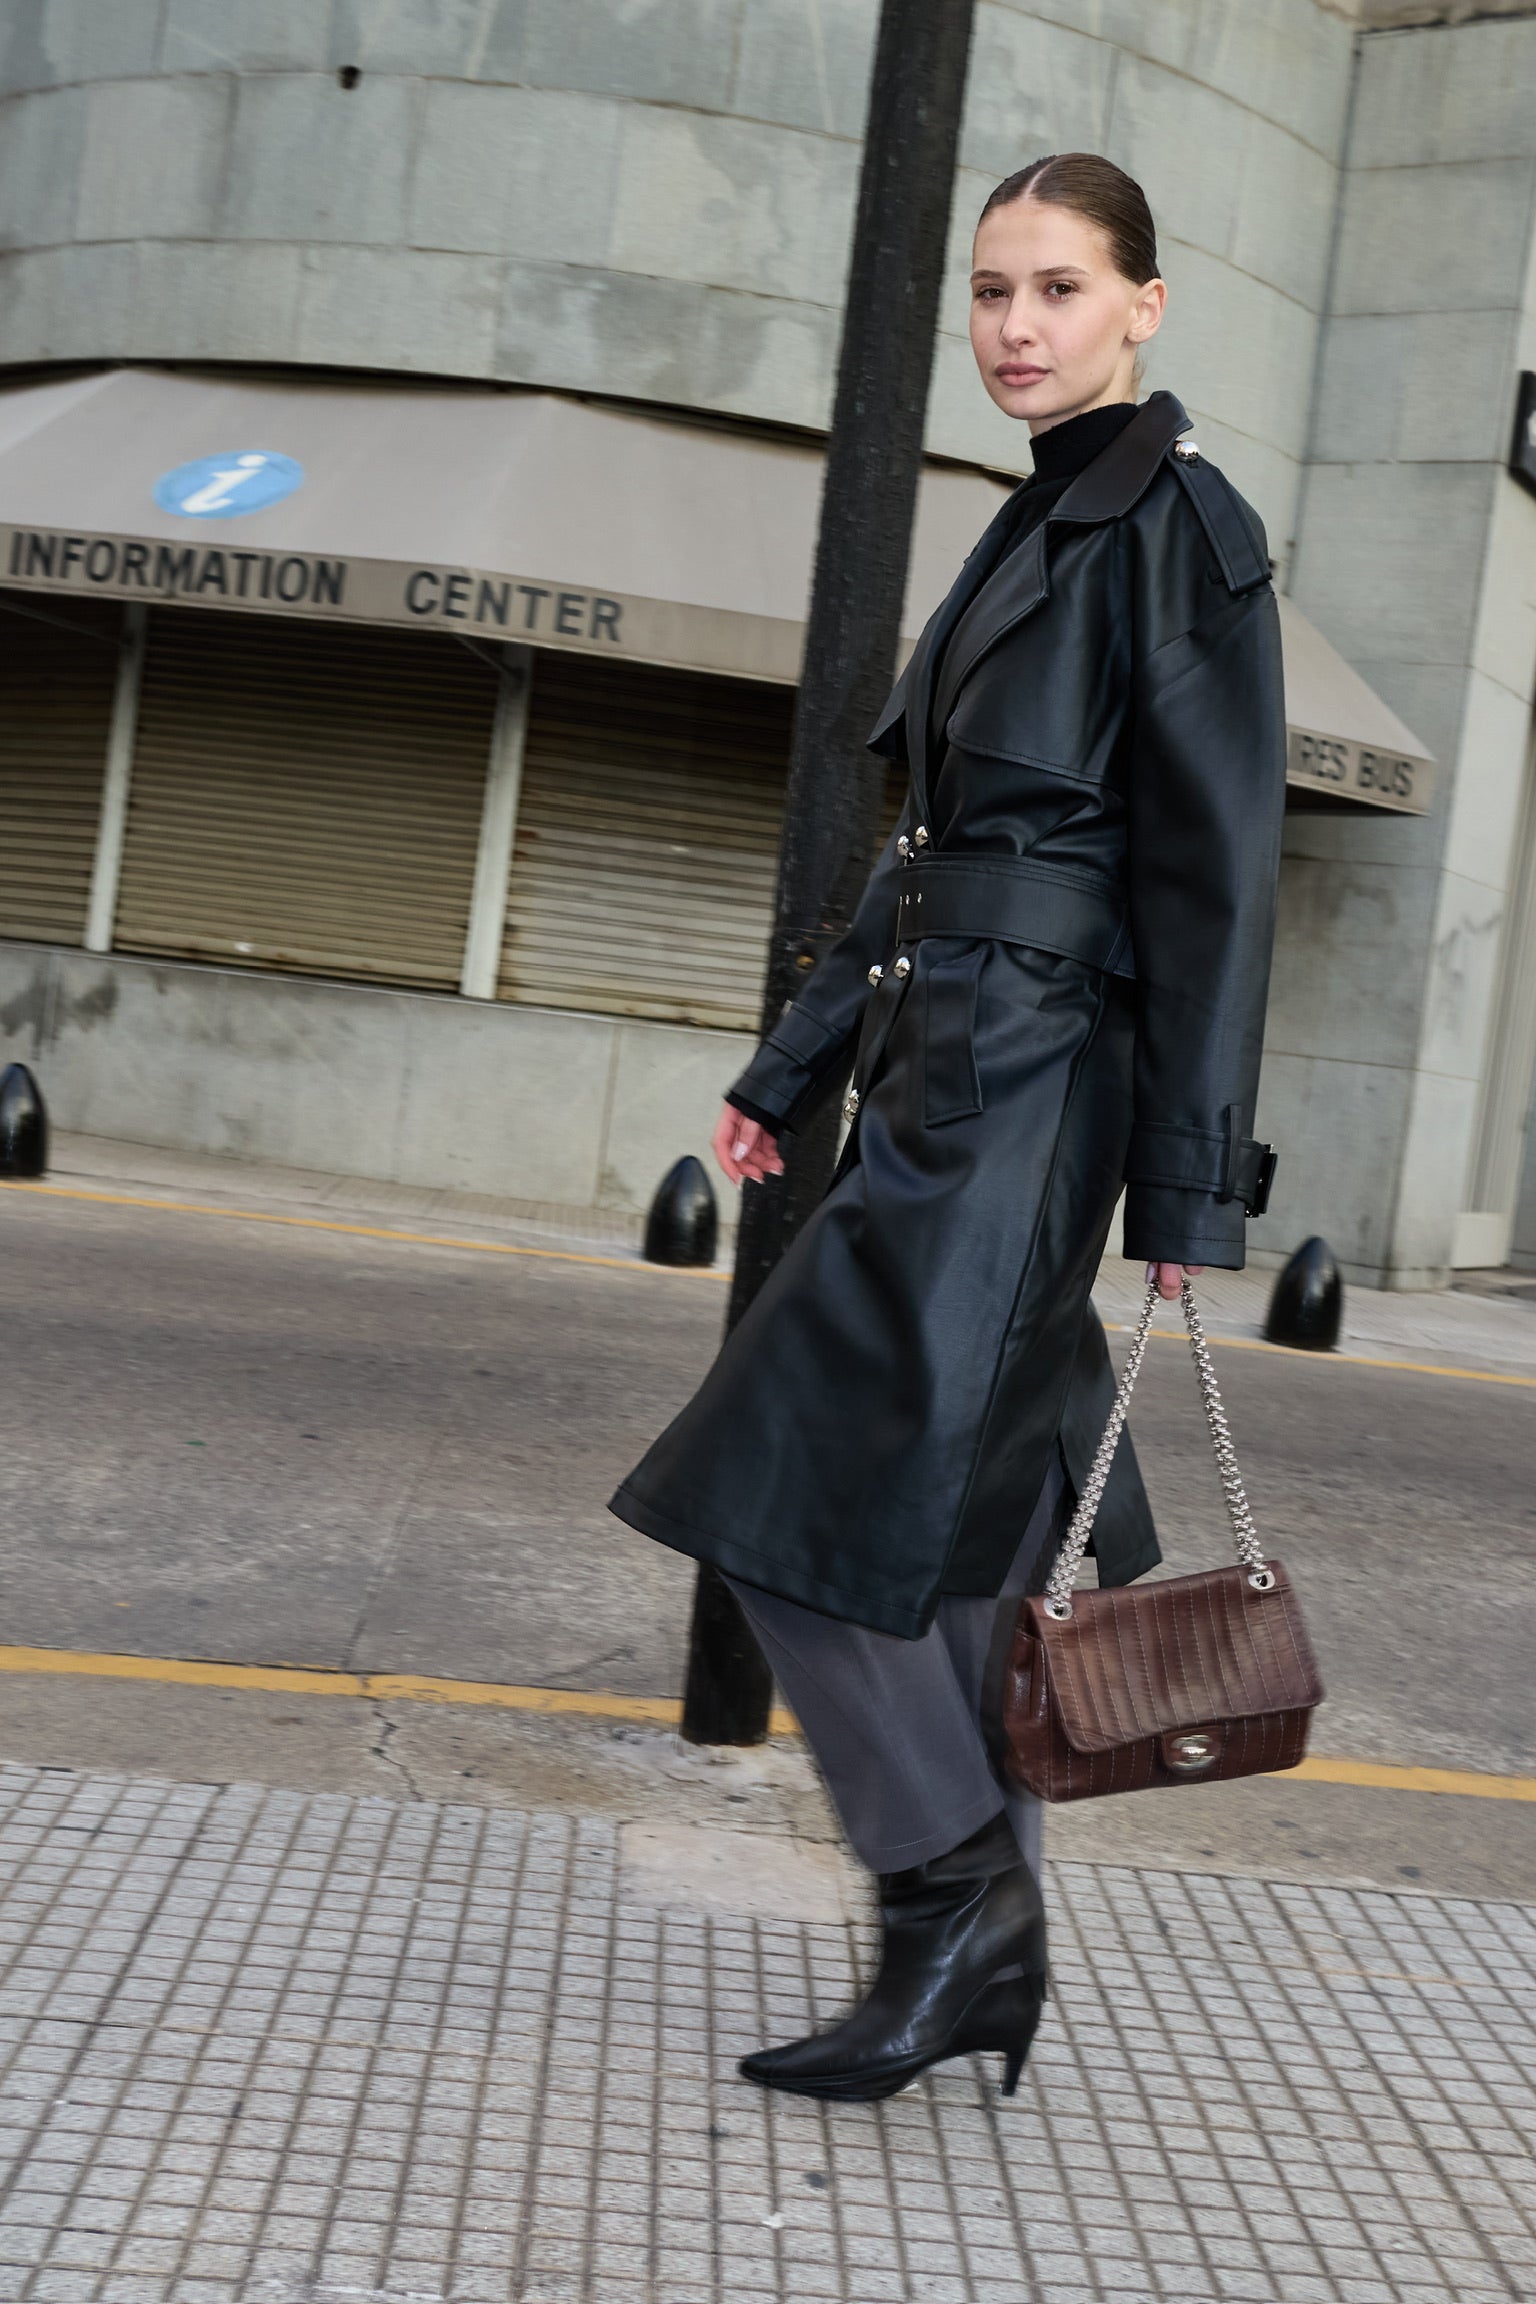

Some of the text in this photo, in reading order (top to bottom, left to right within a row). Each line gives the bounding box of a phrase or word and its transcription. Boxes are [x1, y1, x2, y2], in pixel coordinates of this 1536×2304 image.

[10, 531, 624, 642] INFORMATION CENTER
[1357, 750, 1415, 797] BUS
